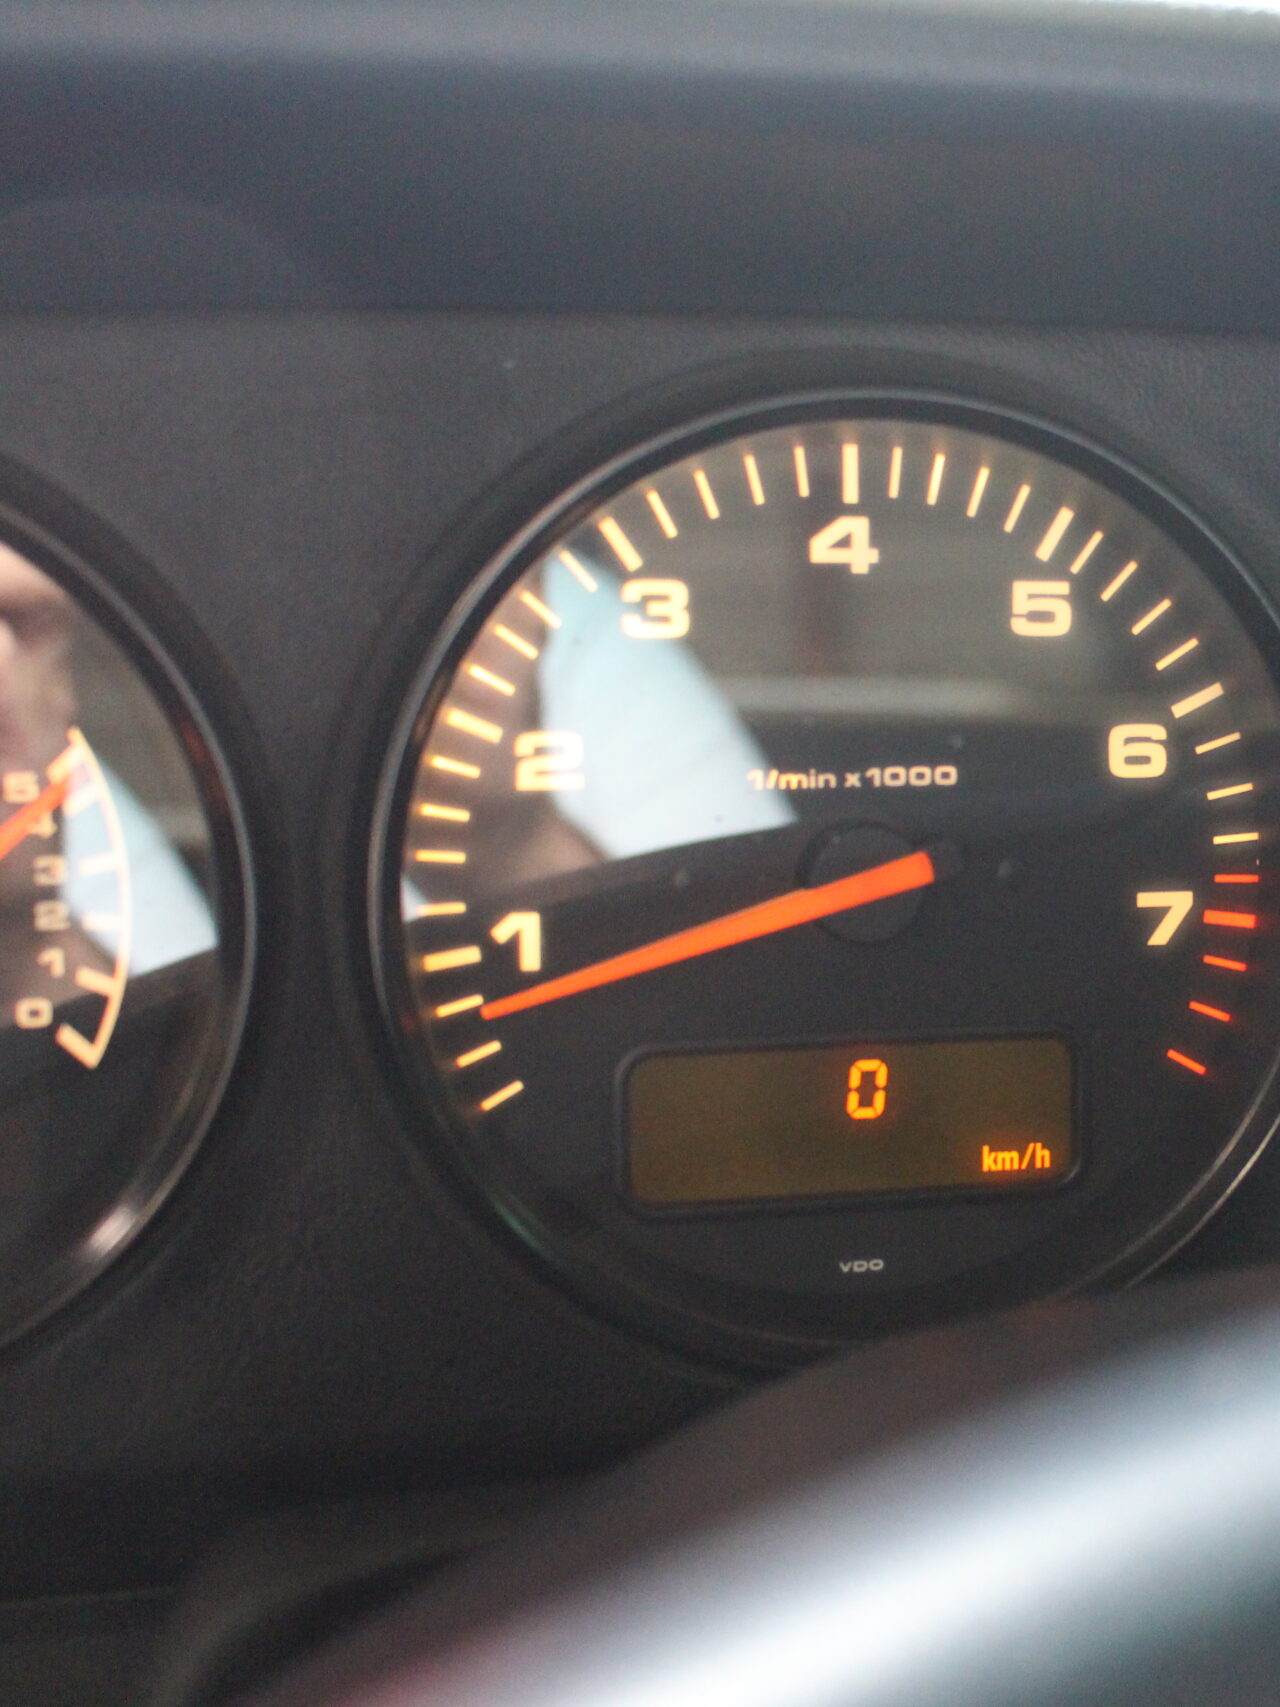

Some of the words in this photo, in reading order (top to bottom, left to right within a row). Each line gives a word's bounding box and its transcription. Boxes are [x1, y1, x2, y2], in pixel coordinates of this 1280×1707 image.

[808, 516, 880, 575] 4
[620, 578, 691, 640] 3
[1010, 580, 1073, 637] 5
[514, 731, 586, 792] 2
[746, 767, 838, 791] 1/min
[1107, 723, 1169, 779] 6
[490, 911, 541, 973] 1
[1136, 890, 1194, 947] 7
[14, 997, 53, 1030] 0
[846, 1058, 889, 1120] 0
[981, 1142, 1052, 1173] km/h
[838, 1259, 885, 1275] VDO
